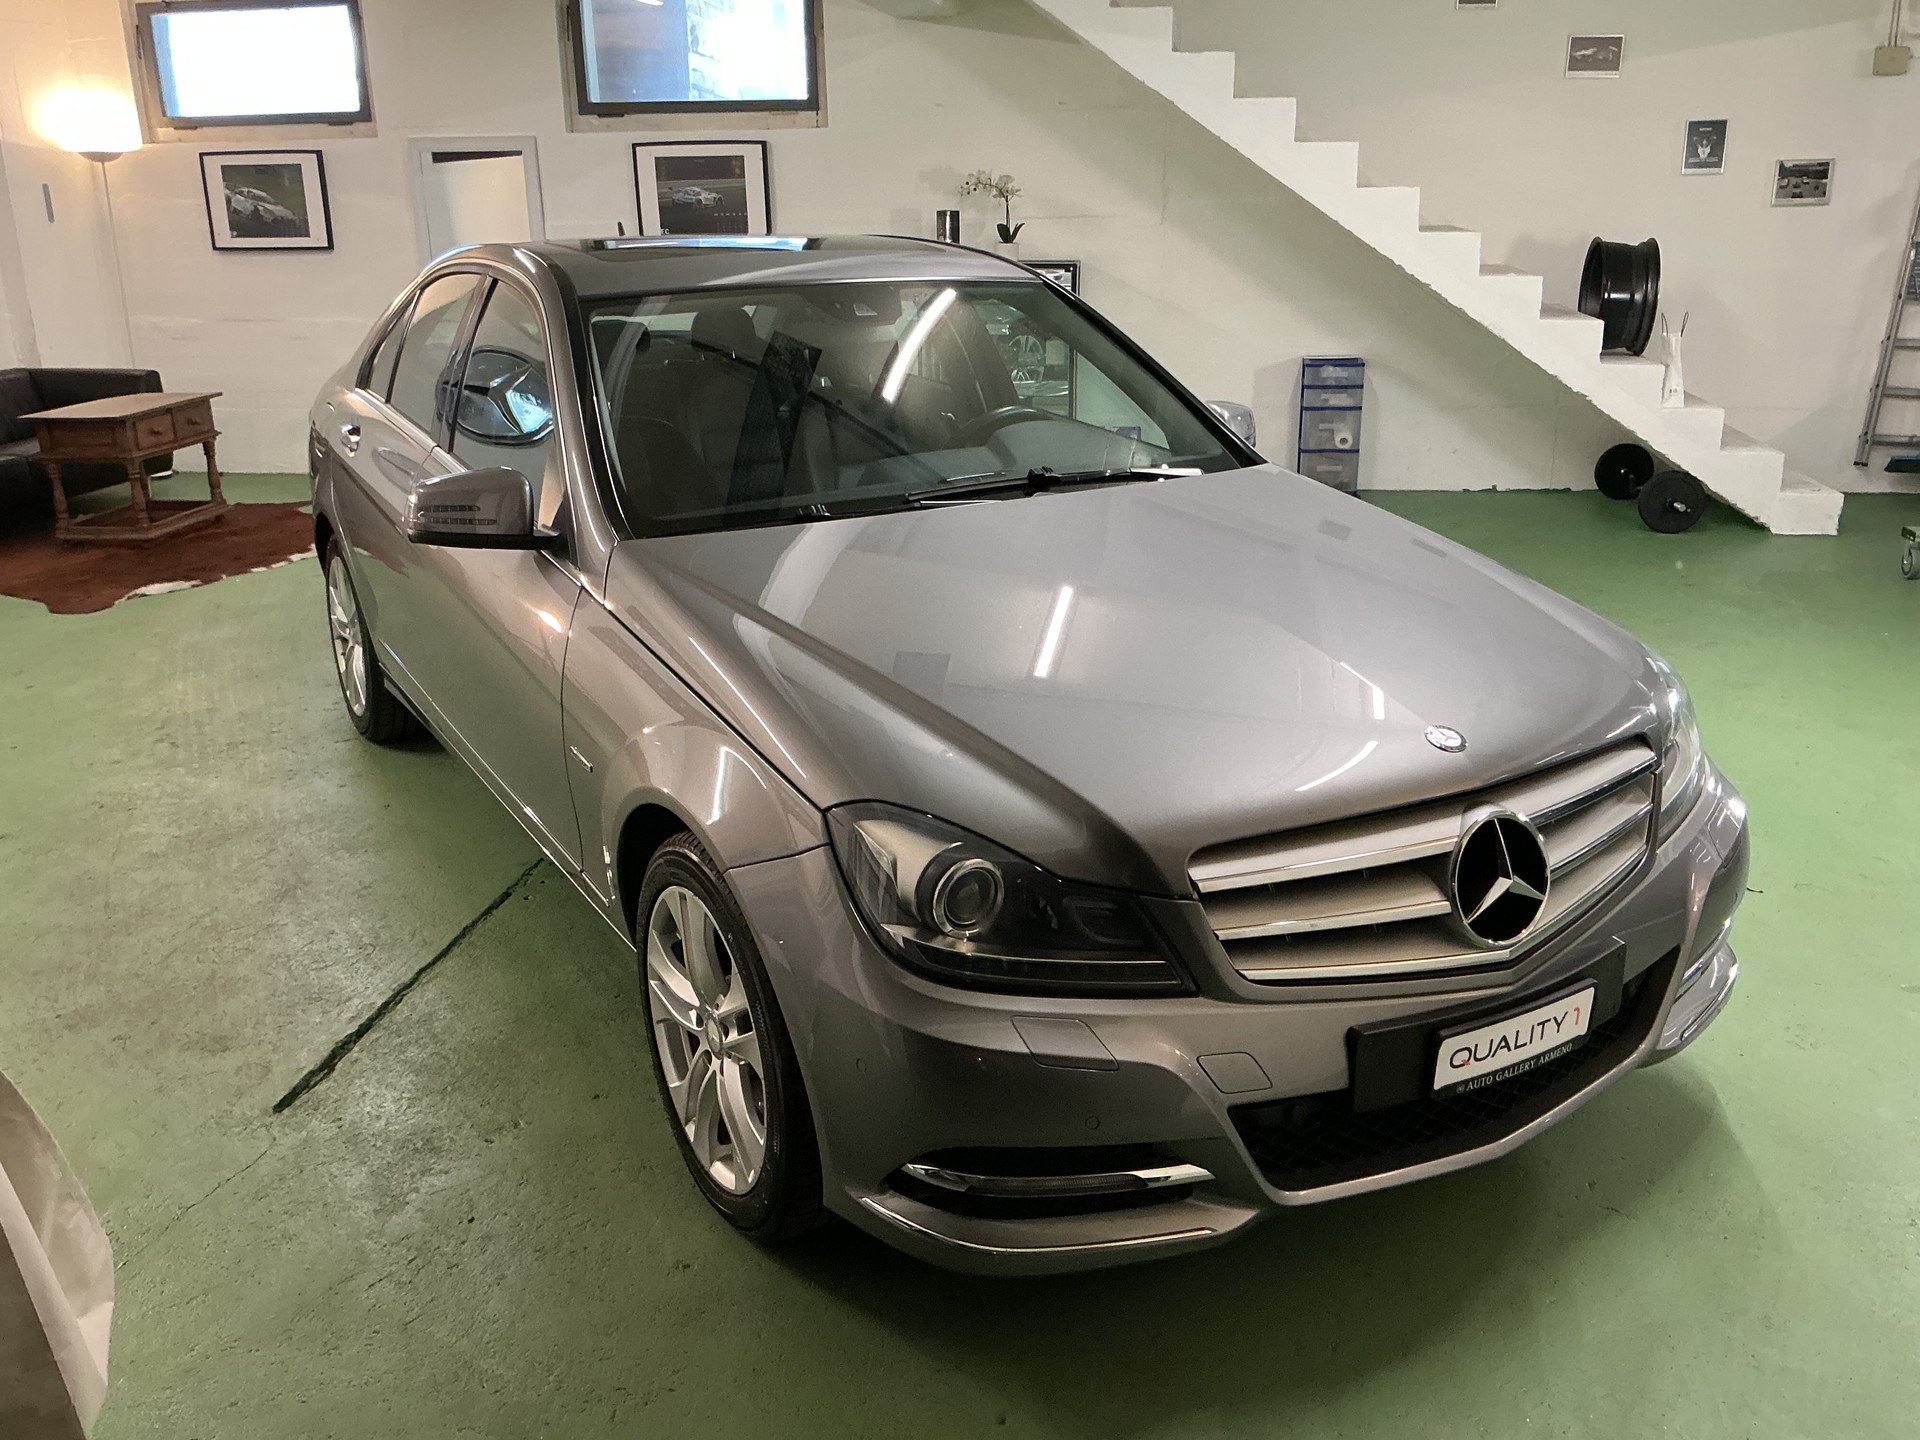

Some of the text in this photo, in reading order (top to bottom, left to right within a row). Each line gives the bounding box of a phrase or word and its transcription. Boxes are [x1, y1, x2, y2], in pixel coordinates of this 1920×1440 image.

[1466, 1042, 1573, 1091] AUTO GALLERY ARMENO
